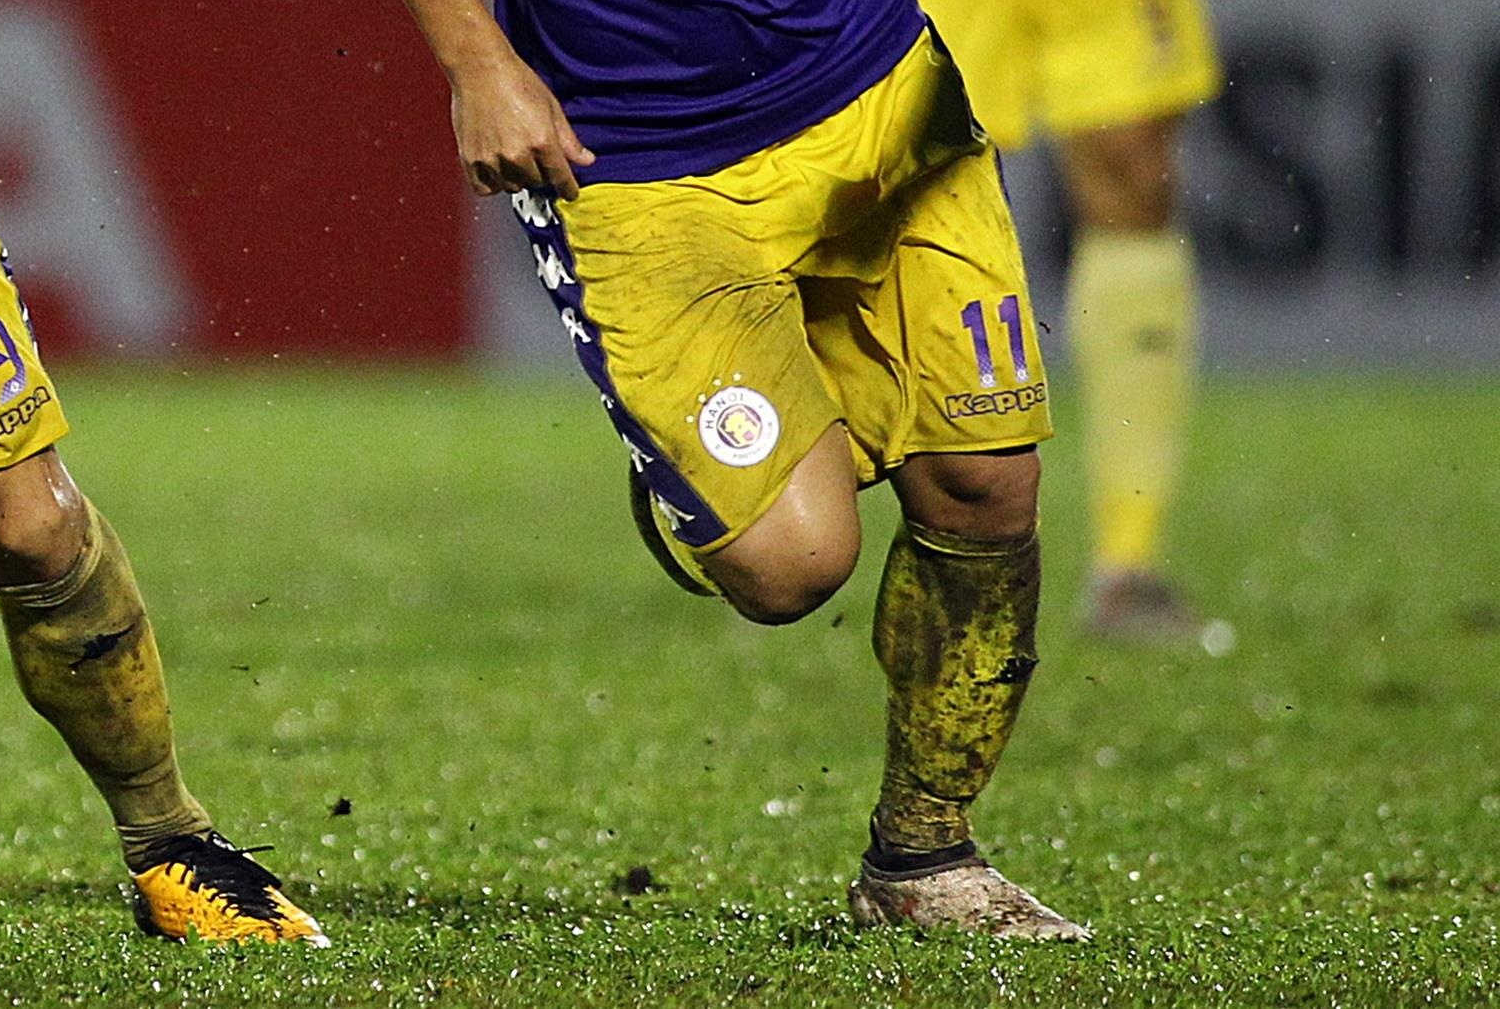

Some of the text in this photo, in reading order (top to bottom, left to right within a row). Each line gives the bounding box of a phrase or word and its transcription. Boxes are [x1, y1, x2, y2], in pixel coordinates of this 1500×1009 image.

[960, 294, 1029, 388] 11
[704, 392, 744, 430] HANOI
[944, 382, 1047, 419] Kappa
